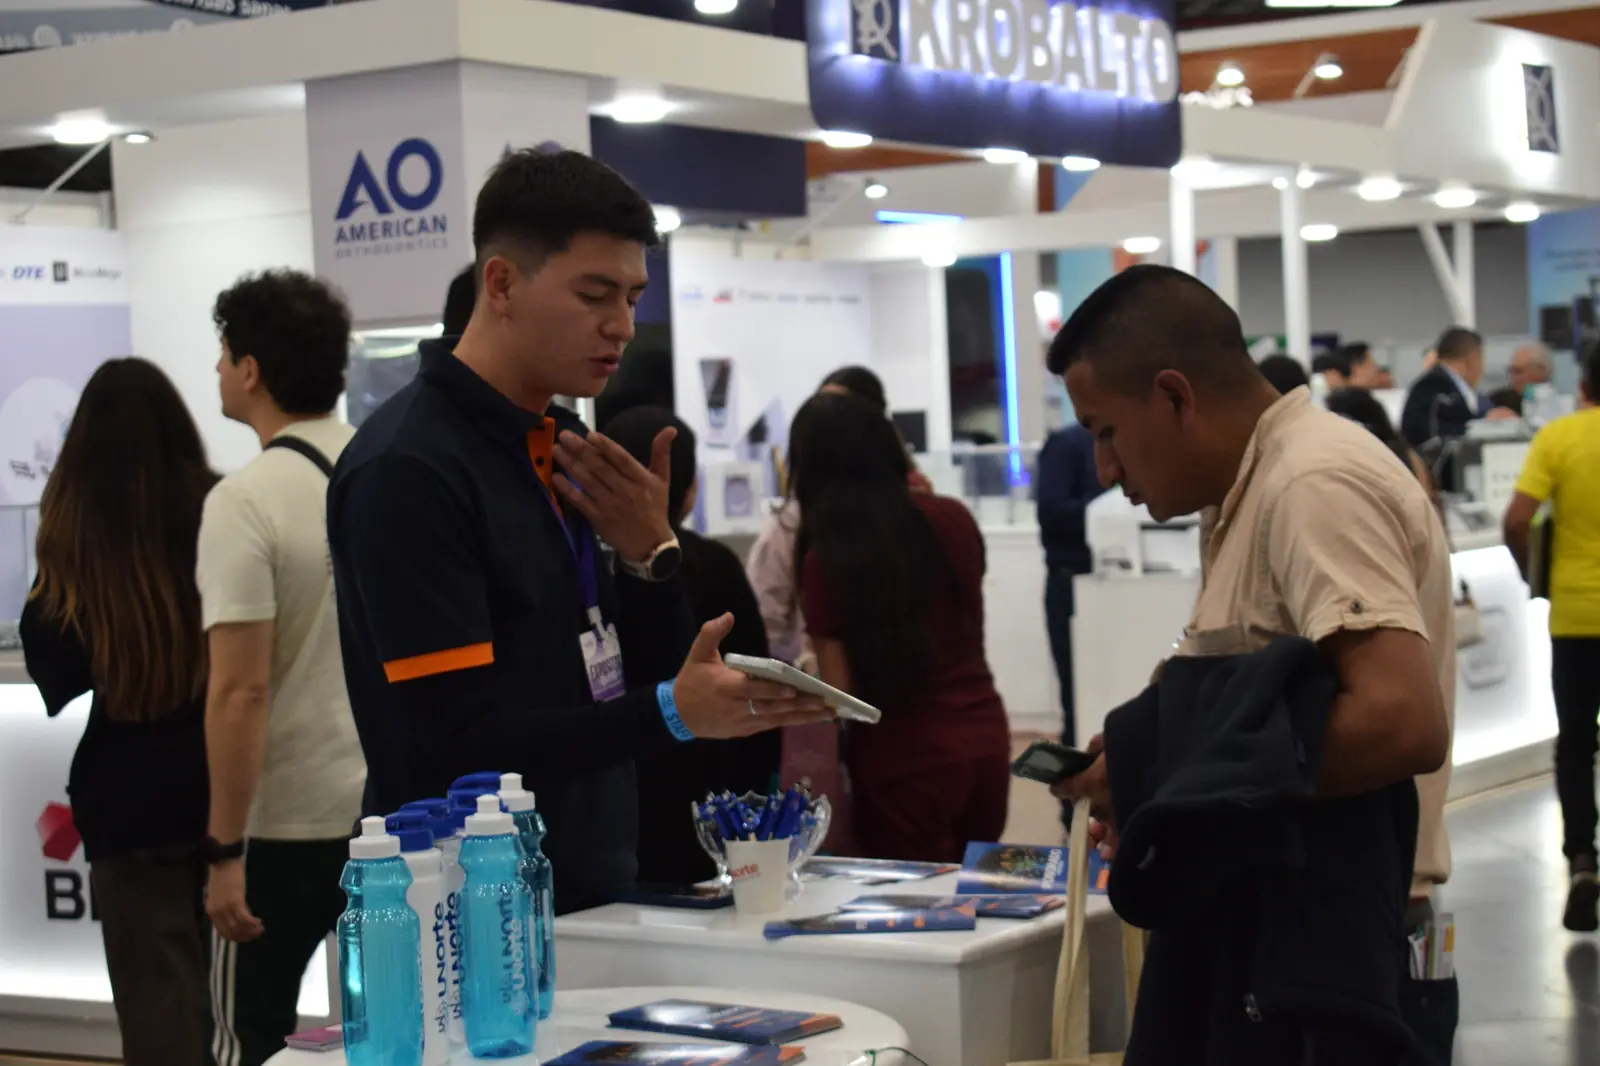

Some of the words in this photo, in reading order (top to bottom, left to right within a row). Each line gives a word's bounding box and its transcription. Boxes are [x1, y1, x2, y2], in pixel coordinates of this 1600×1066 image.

[908, 0, 1177, 102] KROBALTO
[335, 138, 443, 221] AO
[335, 215, 447, 245] AMERICAN
[45, 869, 101, 920] B
